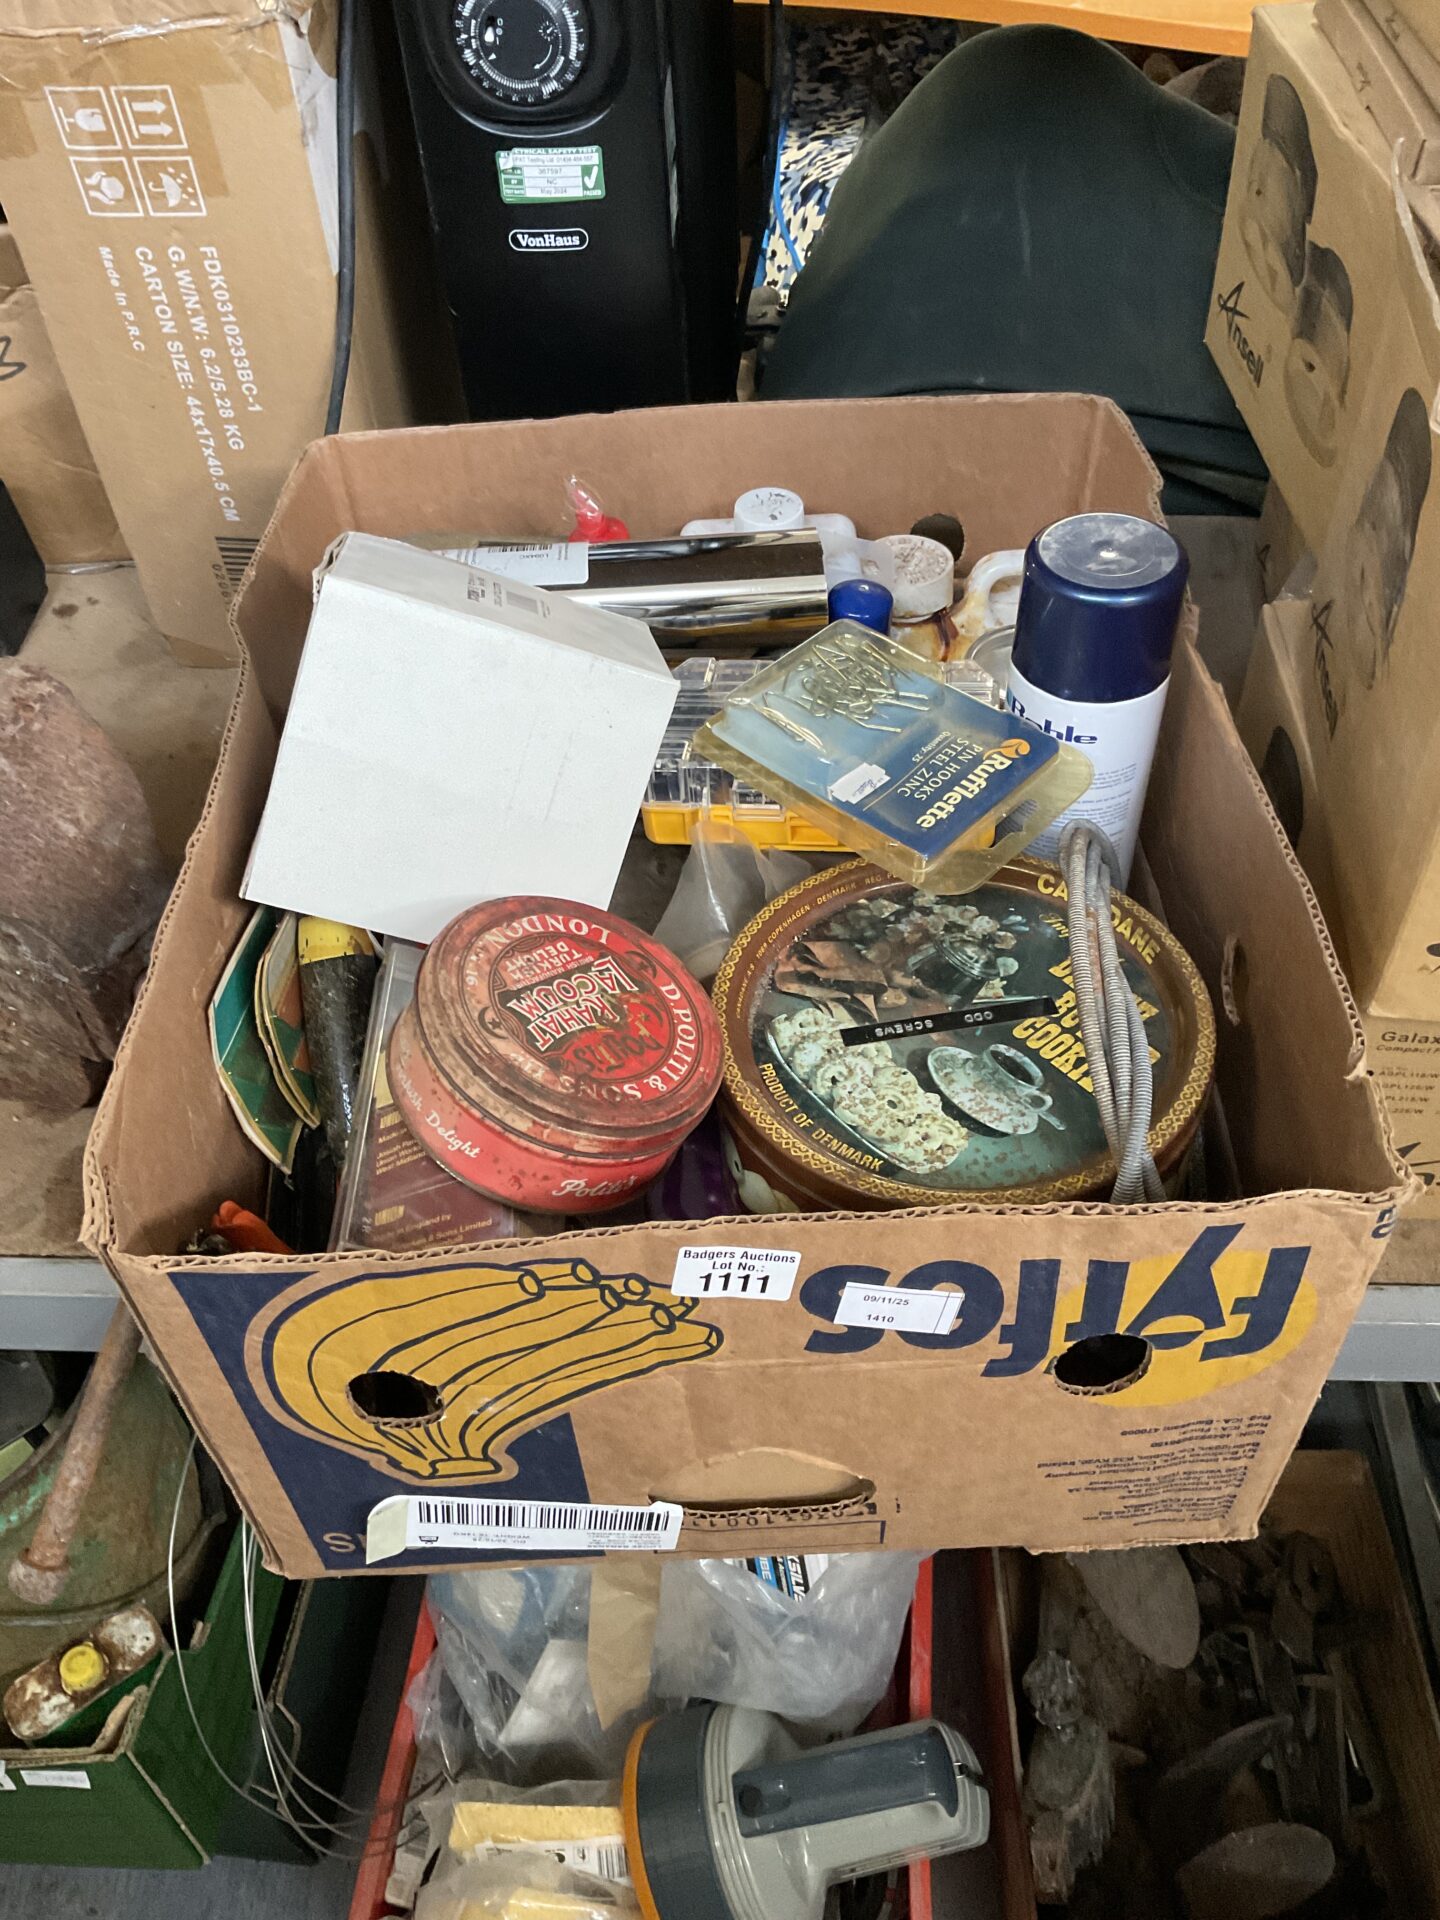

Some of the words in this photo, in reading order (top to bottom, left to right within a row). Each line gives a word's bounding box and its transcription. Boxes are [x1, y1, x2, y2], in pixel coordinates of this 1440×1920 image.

[516, 233, 581, 248] VonHaus
[100, 246, 121, 287] Made
[121, 310, 145, 351] P.R.C
[199, 245, 262, 412] FDK0310233BC-1
[135, 246, 178, 334] CARTON
[166, 340, 195, 389] SIZE:
[186, 395, 230, 491] 44x17x40.5
[219, 496, 241, 522] CM
[200, 347, 235, 418] 6.2/5.28
[223, 424, 245, 450] KG
[911, 753, 924, 763] 25
[929, 737, 969, 766] STEEL
[957, 743, 984, 763] PIN
[897, 767, 934, 797] ZINC
[913, 762, 961, 801] HOOKS
[915, 753, 1013, 828] Rufflette
[767, 903, 811, 944] COPENHAGEN
[504, 941, 570, 972] DELIGHT
[510, 948, 583, 982] TURKISH
[875, 1019, 934, 1037] SCREWS
[964, 1010, 993, 1023] ODD
[643, 1075, 667, 1093] &
[760, 1062, 799, 1113] PRODUCT
[793, 1112, 814, 1128] OF
[811, 1128, 884, 1172] DENMARK
[424, 1109, 481, 1158] Delight
[459, 1217, 493, 1232] Limited
[683, 1249, 736, 1260] Badgers
[740, 1250, 796, 1263] Auctions
[711, 1260, 732, 1271] Lot
[699, 1272, 770, 1294] 1111
[863, 1294, 910, 1306] 09/11/25
[866, 1313, 894, 1323] 1410
